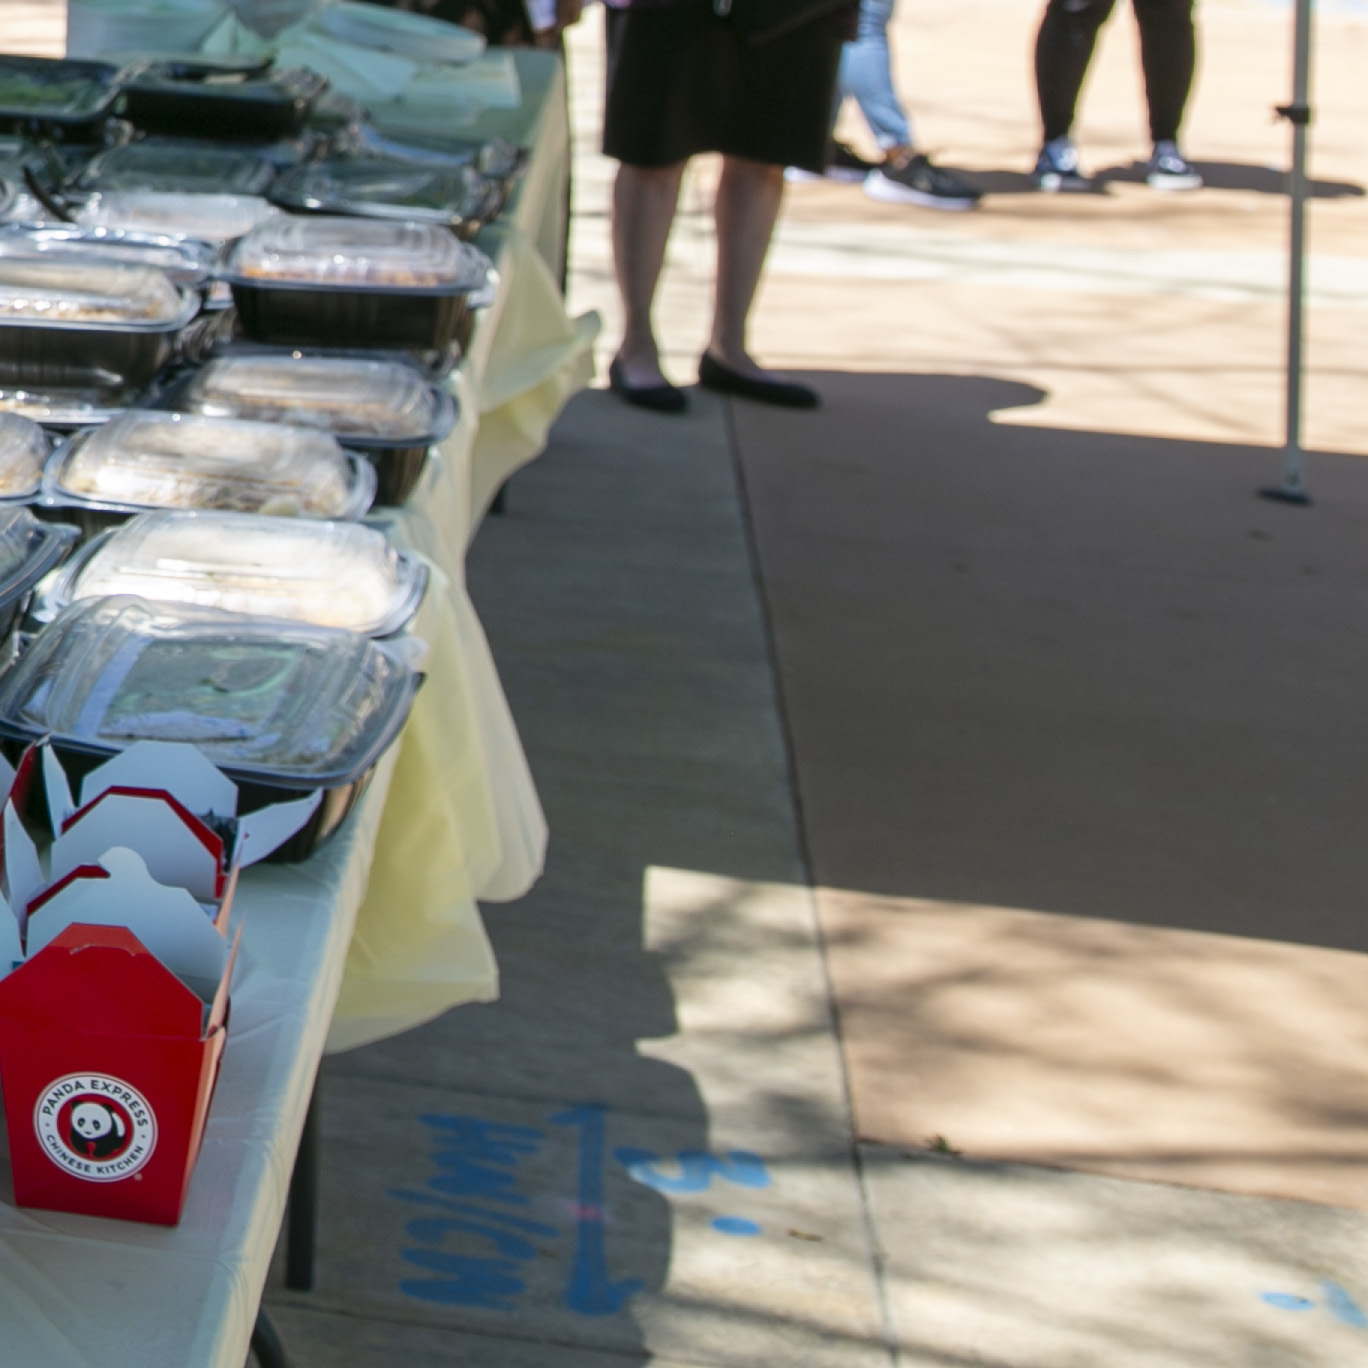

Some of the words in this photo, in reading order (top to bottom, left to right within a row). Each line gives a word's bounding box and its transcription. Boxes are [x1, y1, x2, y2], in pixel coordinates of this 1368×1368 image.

[42, 1080, 85, 1116] PANDA
[90, 1079, 149, 1127] EXPRESS
[46, 1134, 91, 1173] CHINESE
[96, 1145, 144, 1174] KITCHEN
